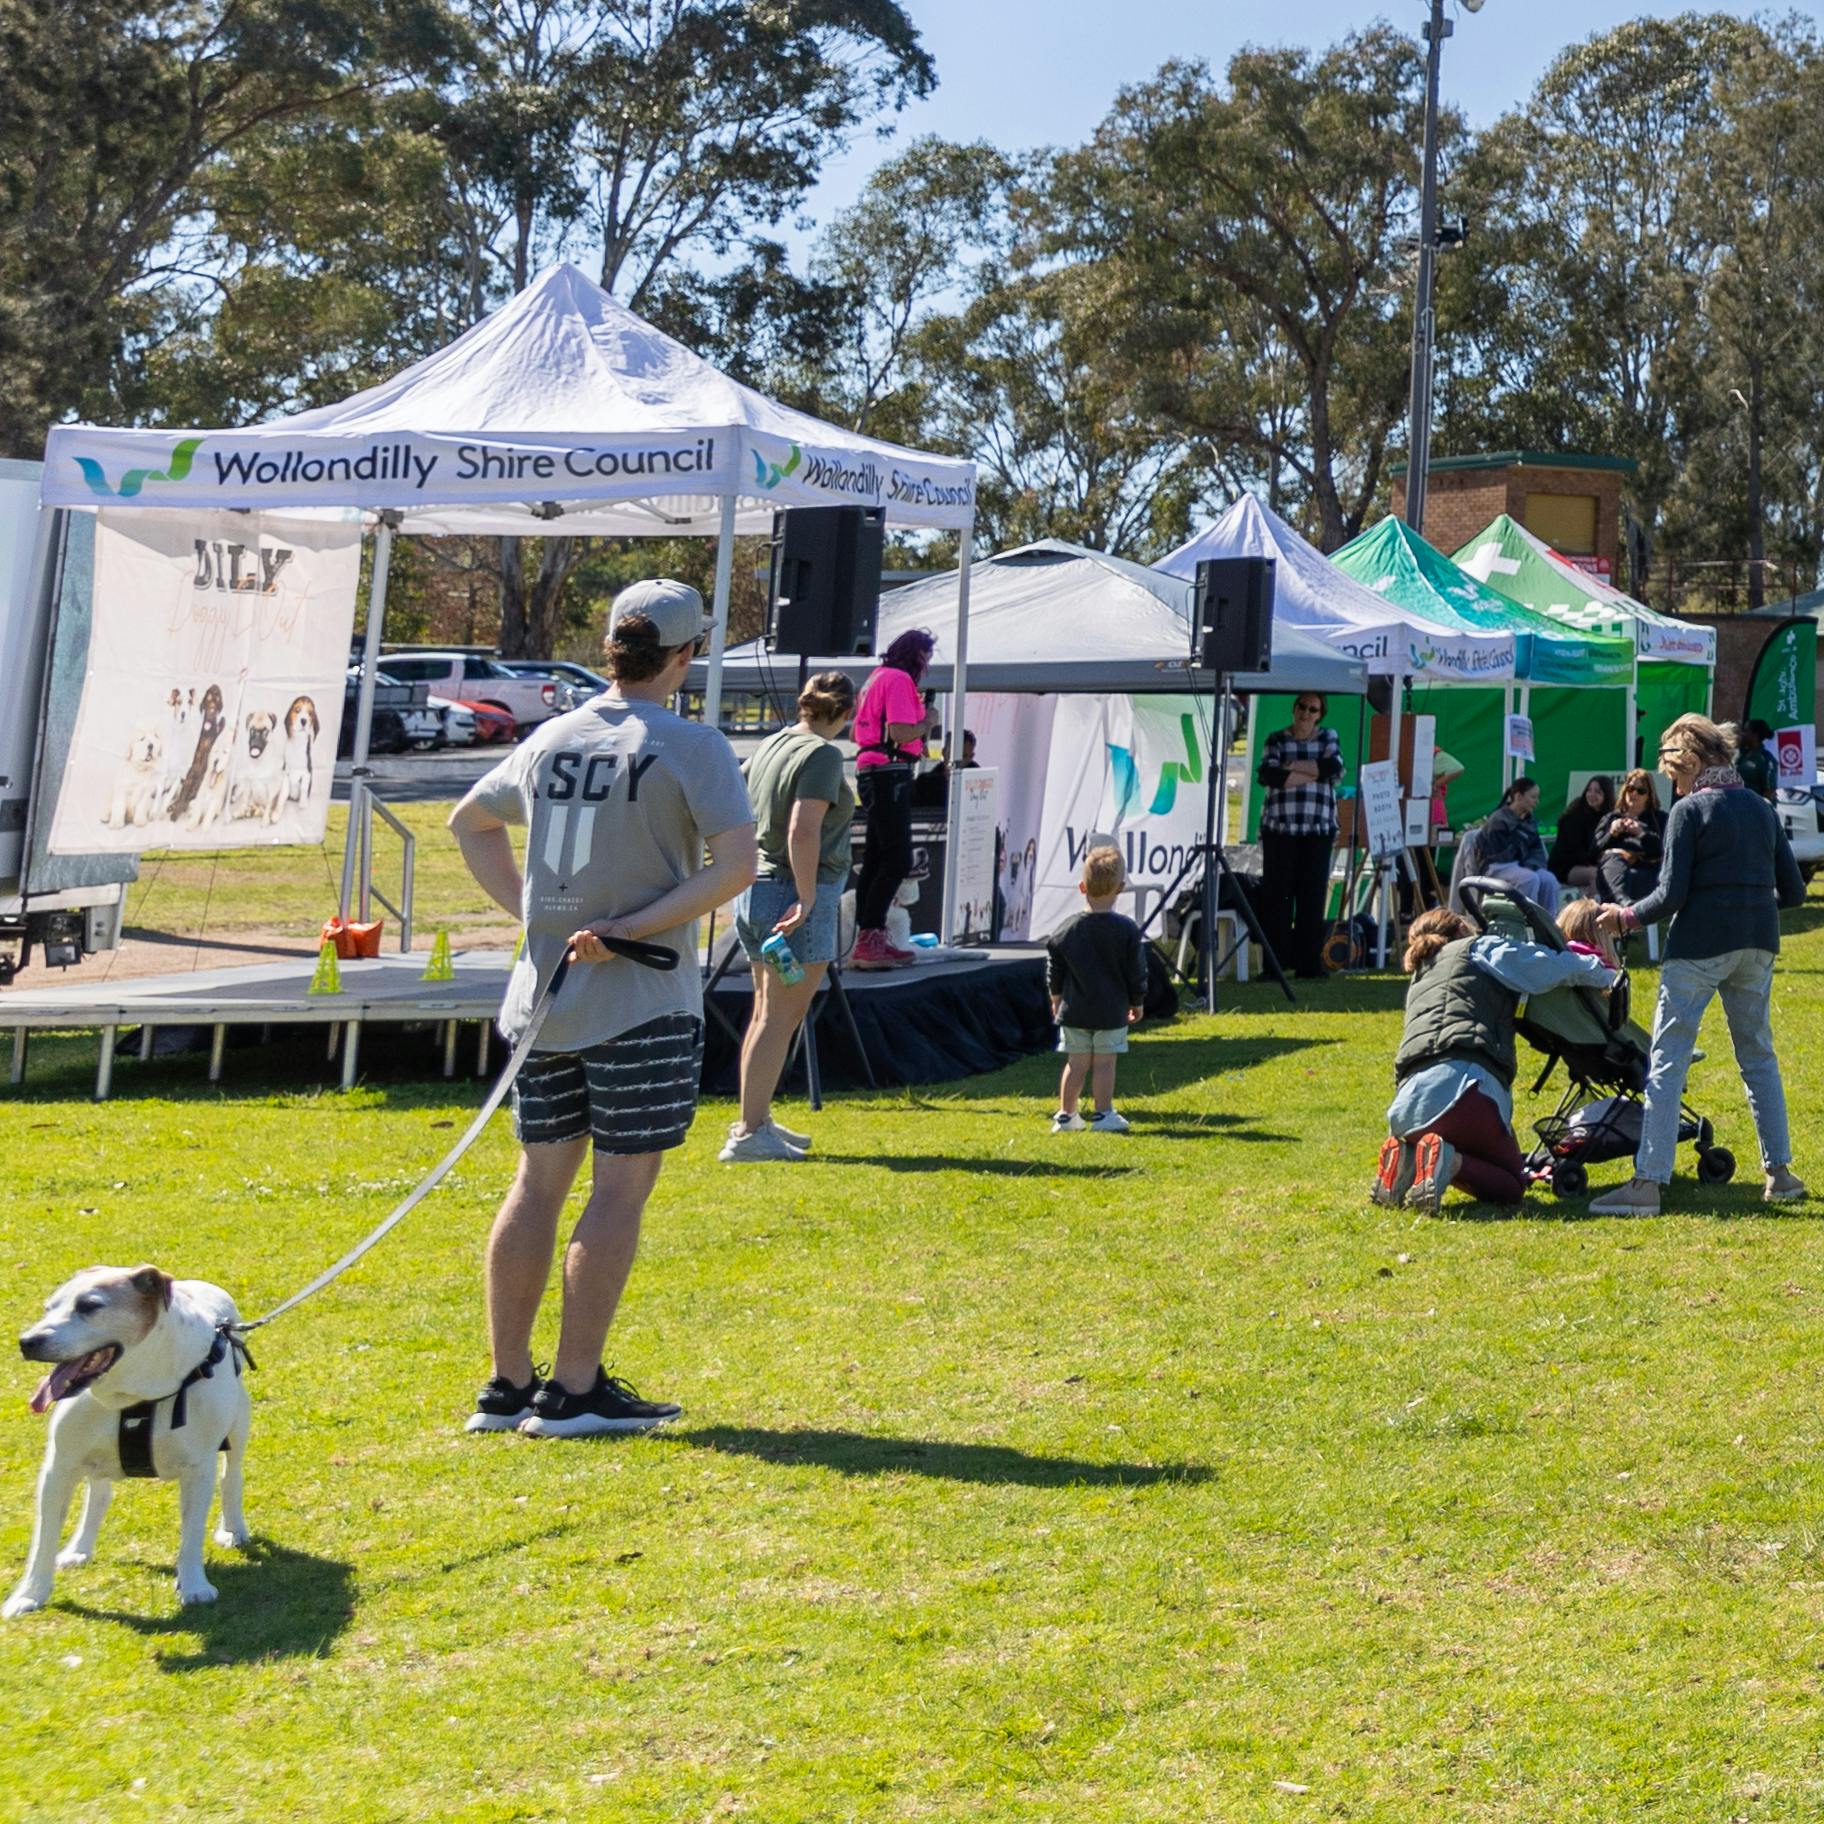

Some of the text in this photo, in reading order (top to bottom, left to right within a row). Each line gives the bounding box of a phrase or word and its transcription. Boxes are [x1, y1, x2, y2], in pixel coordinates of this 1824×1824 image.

[214, 438, 714, 489] Wollondilly Shire Council
[1336, 636, 1388, 658] ncil
